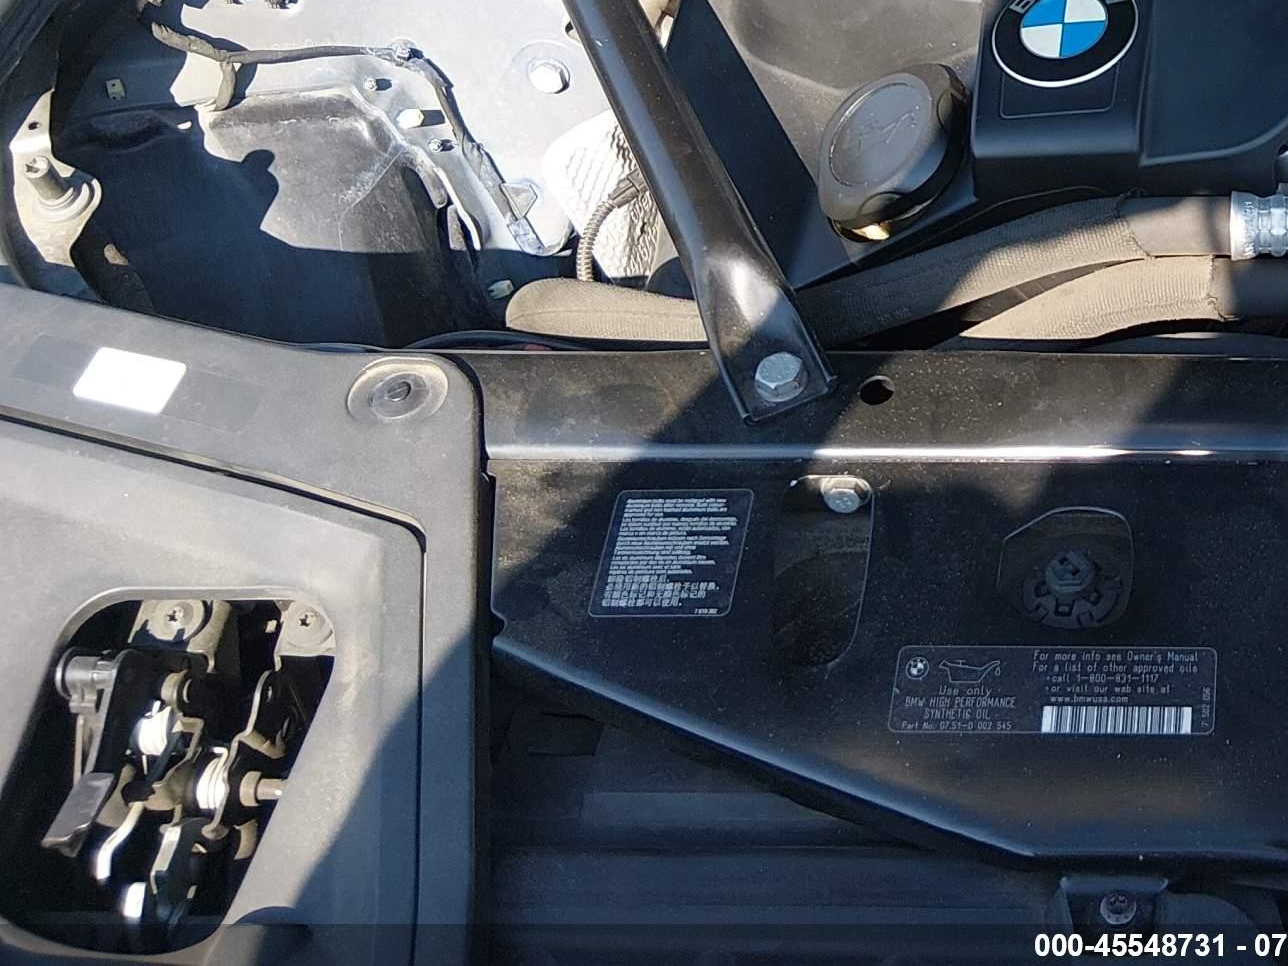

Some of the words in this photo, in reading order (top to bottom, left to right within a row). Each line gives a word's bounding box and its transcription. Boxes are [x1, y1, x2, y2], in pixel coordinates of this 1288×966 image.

[1033, 649, 1049, 661] For
[1054, 653, 1077, 661] more
[1082, 650, 1101, 661] info
[1106, 653, 1122, 661] see
[1167, 651, 1199, 662] Manual
[1032, 661, 1048, 672] For
[1065, 661, 1081, 672] list
[1087, 661, 1097, 672] of
[1103, 661, 1127, 672] other
[1133, 663, 1175, 674] approved
[939, 685, 960, 695] Use
[966, 685, 992, 697] only
[1066, 684, 1088, 692] visit
[1114, 685, 1132, 693] web
[905, 696, 926, 707] BMW
[929, 696, 951, 707] HIGH
[954, 696, 1017, 708] PERFORMANCE
[1050, 694, 1129, 703] www.bmwusa.com
[975, 709, 991, 719] OIL
[902, 720, 919, 729] Part
